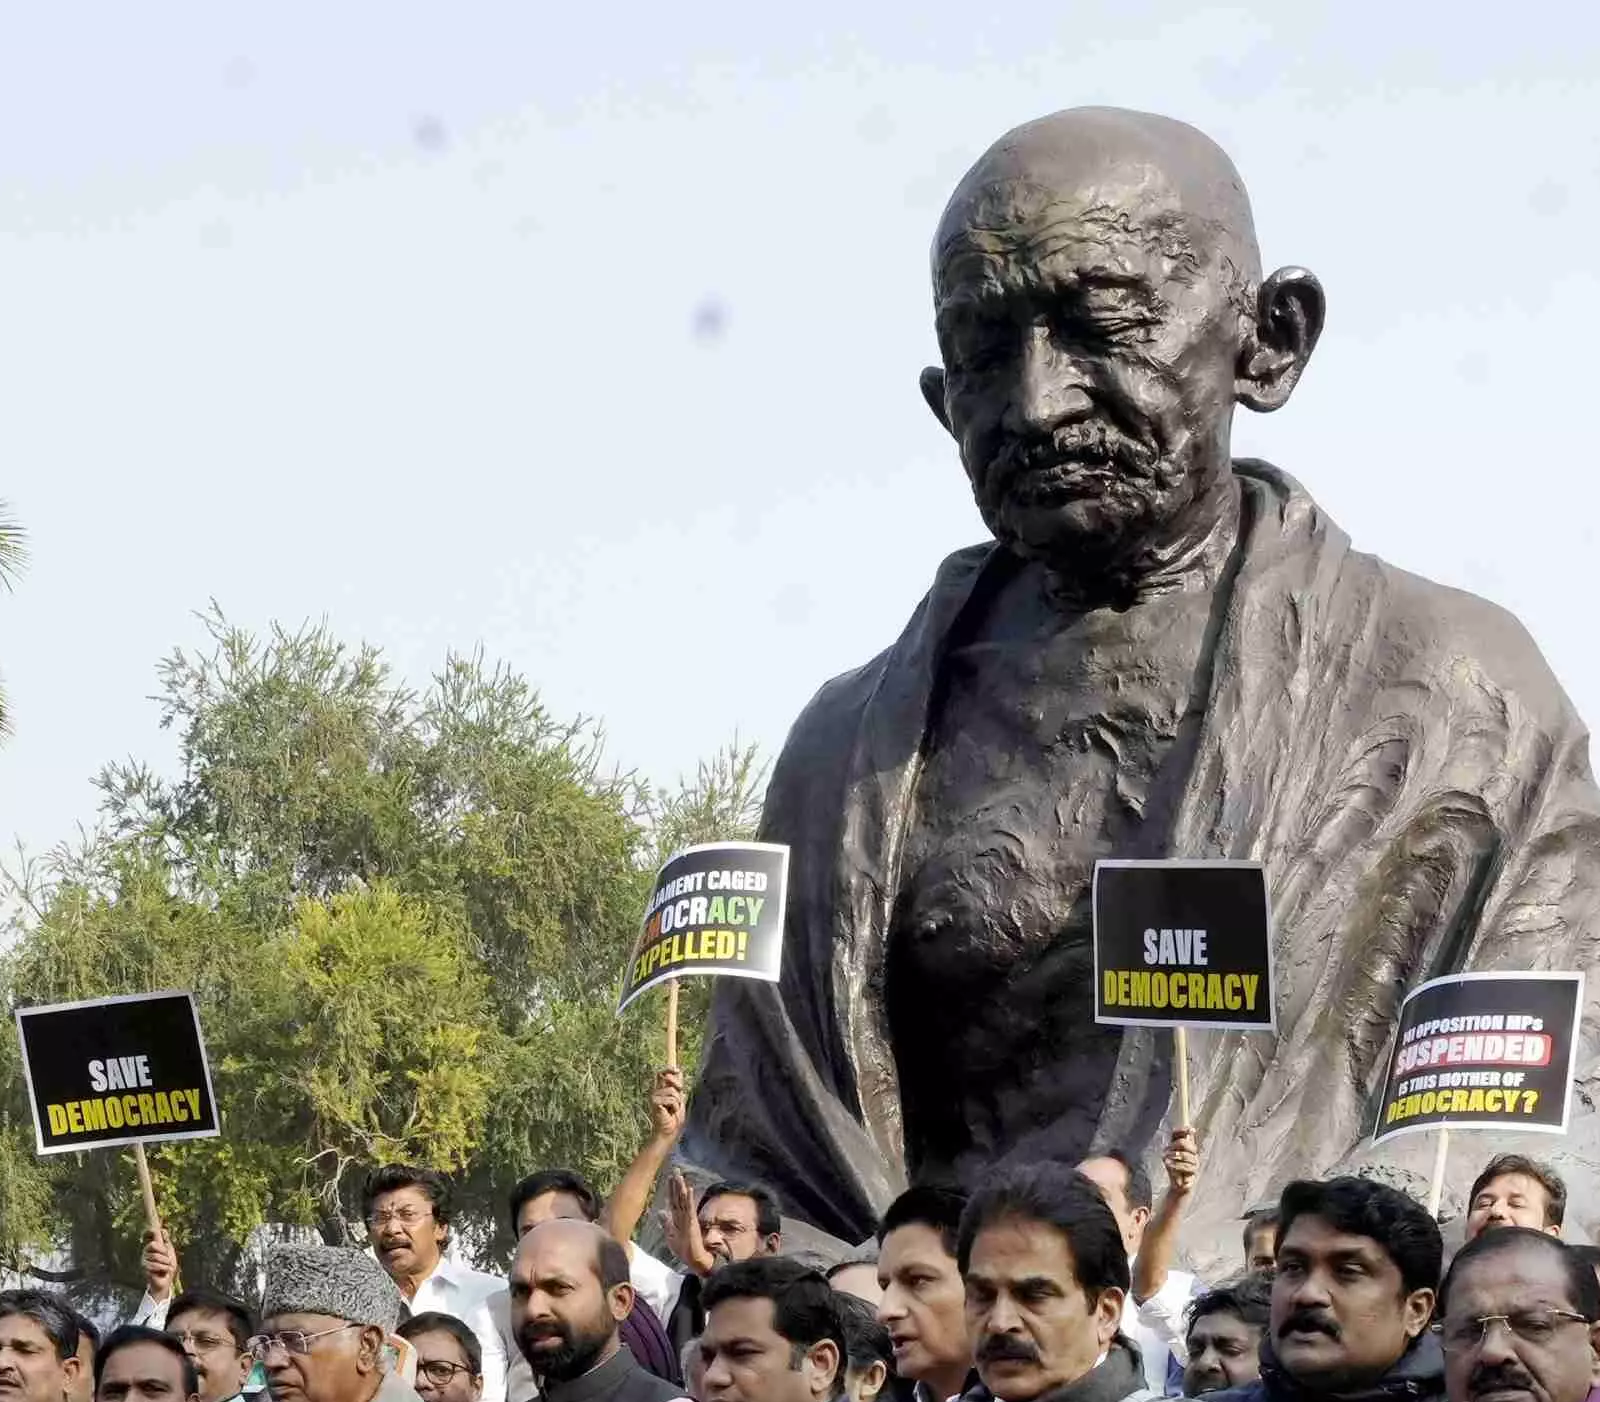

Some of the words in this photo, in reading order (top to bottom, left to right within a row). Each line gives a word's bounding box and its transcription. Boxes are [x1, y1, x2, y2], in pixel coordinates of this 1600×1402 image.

[708, 870, 768, 891] CAGED
[1143, 928, 1208, 965] SAVE
[1103, 969, 1259, 1010] DEMOCRACY
[1417, 1015, 1504, 1038] OPPOSITION
[1396, 1034, 1545, 1074] SUSPENDED
[87, 1055, 153, 1092] SAVE
[1409, 1074, 1437, 1091] THIS
[1438, 1072, 1501, 1087] MOTHER
[1502, 1072, 1526, 1087] OF
[47, 1088, 201, 1136] DEMOCRACY
